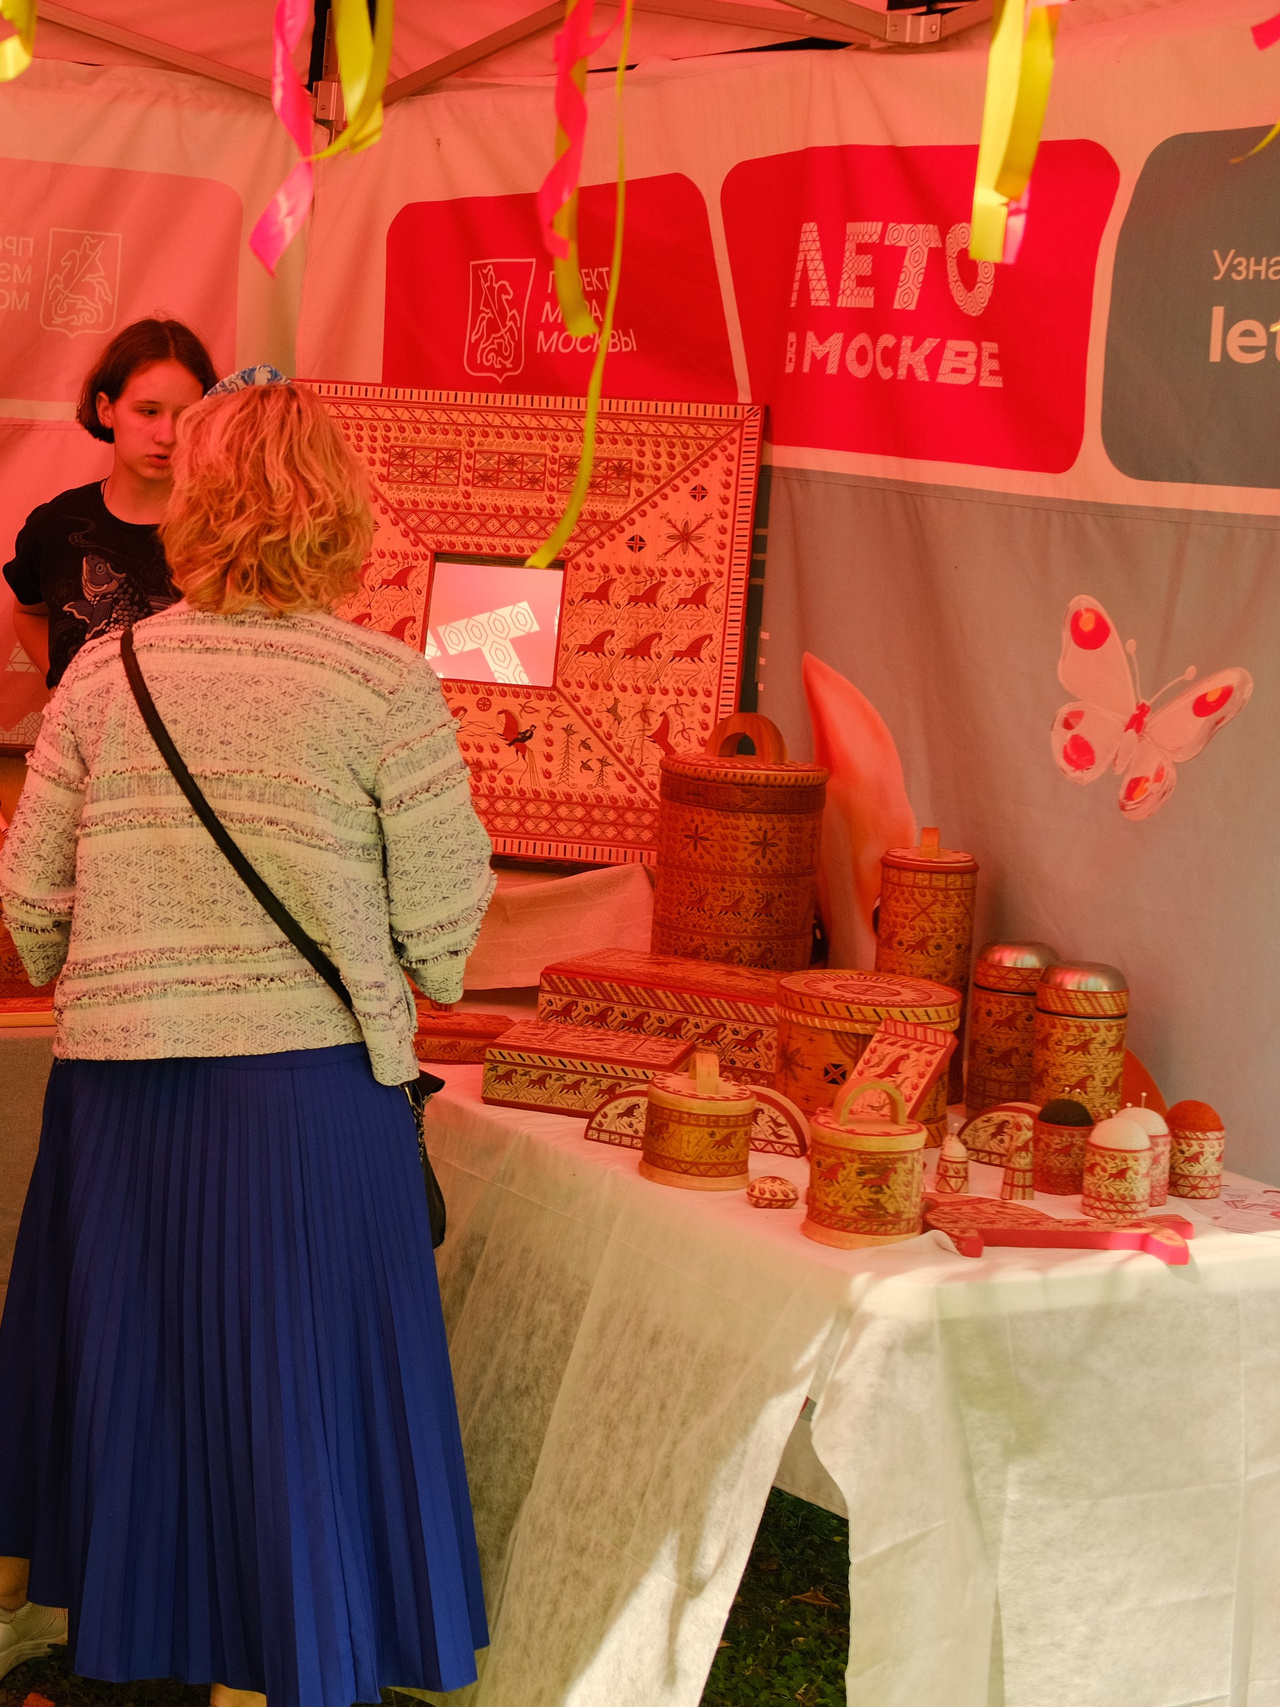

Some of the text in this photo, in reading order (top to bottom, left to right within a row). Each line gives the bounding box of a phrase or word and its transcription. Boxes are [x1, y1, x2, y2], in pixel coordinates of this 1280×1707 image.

[790, 221, 995, 316] ЛЕТО
[541, 299, 604, 323] МА
[802, 330, 1003, 388] МОСКВЕ
